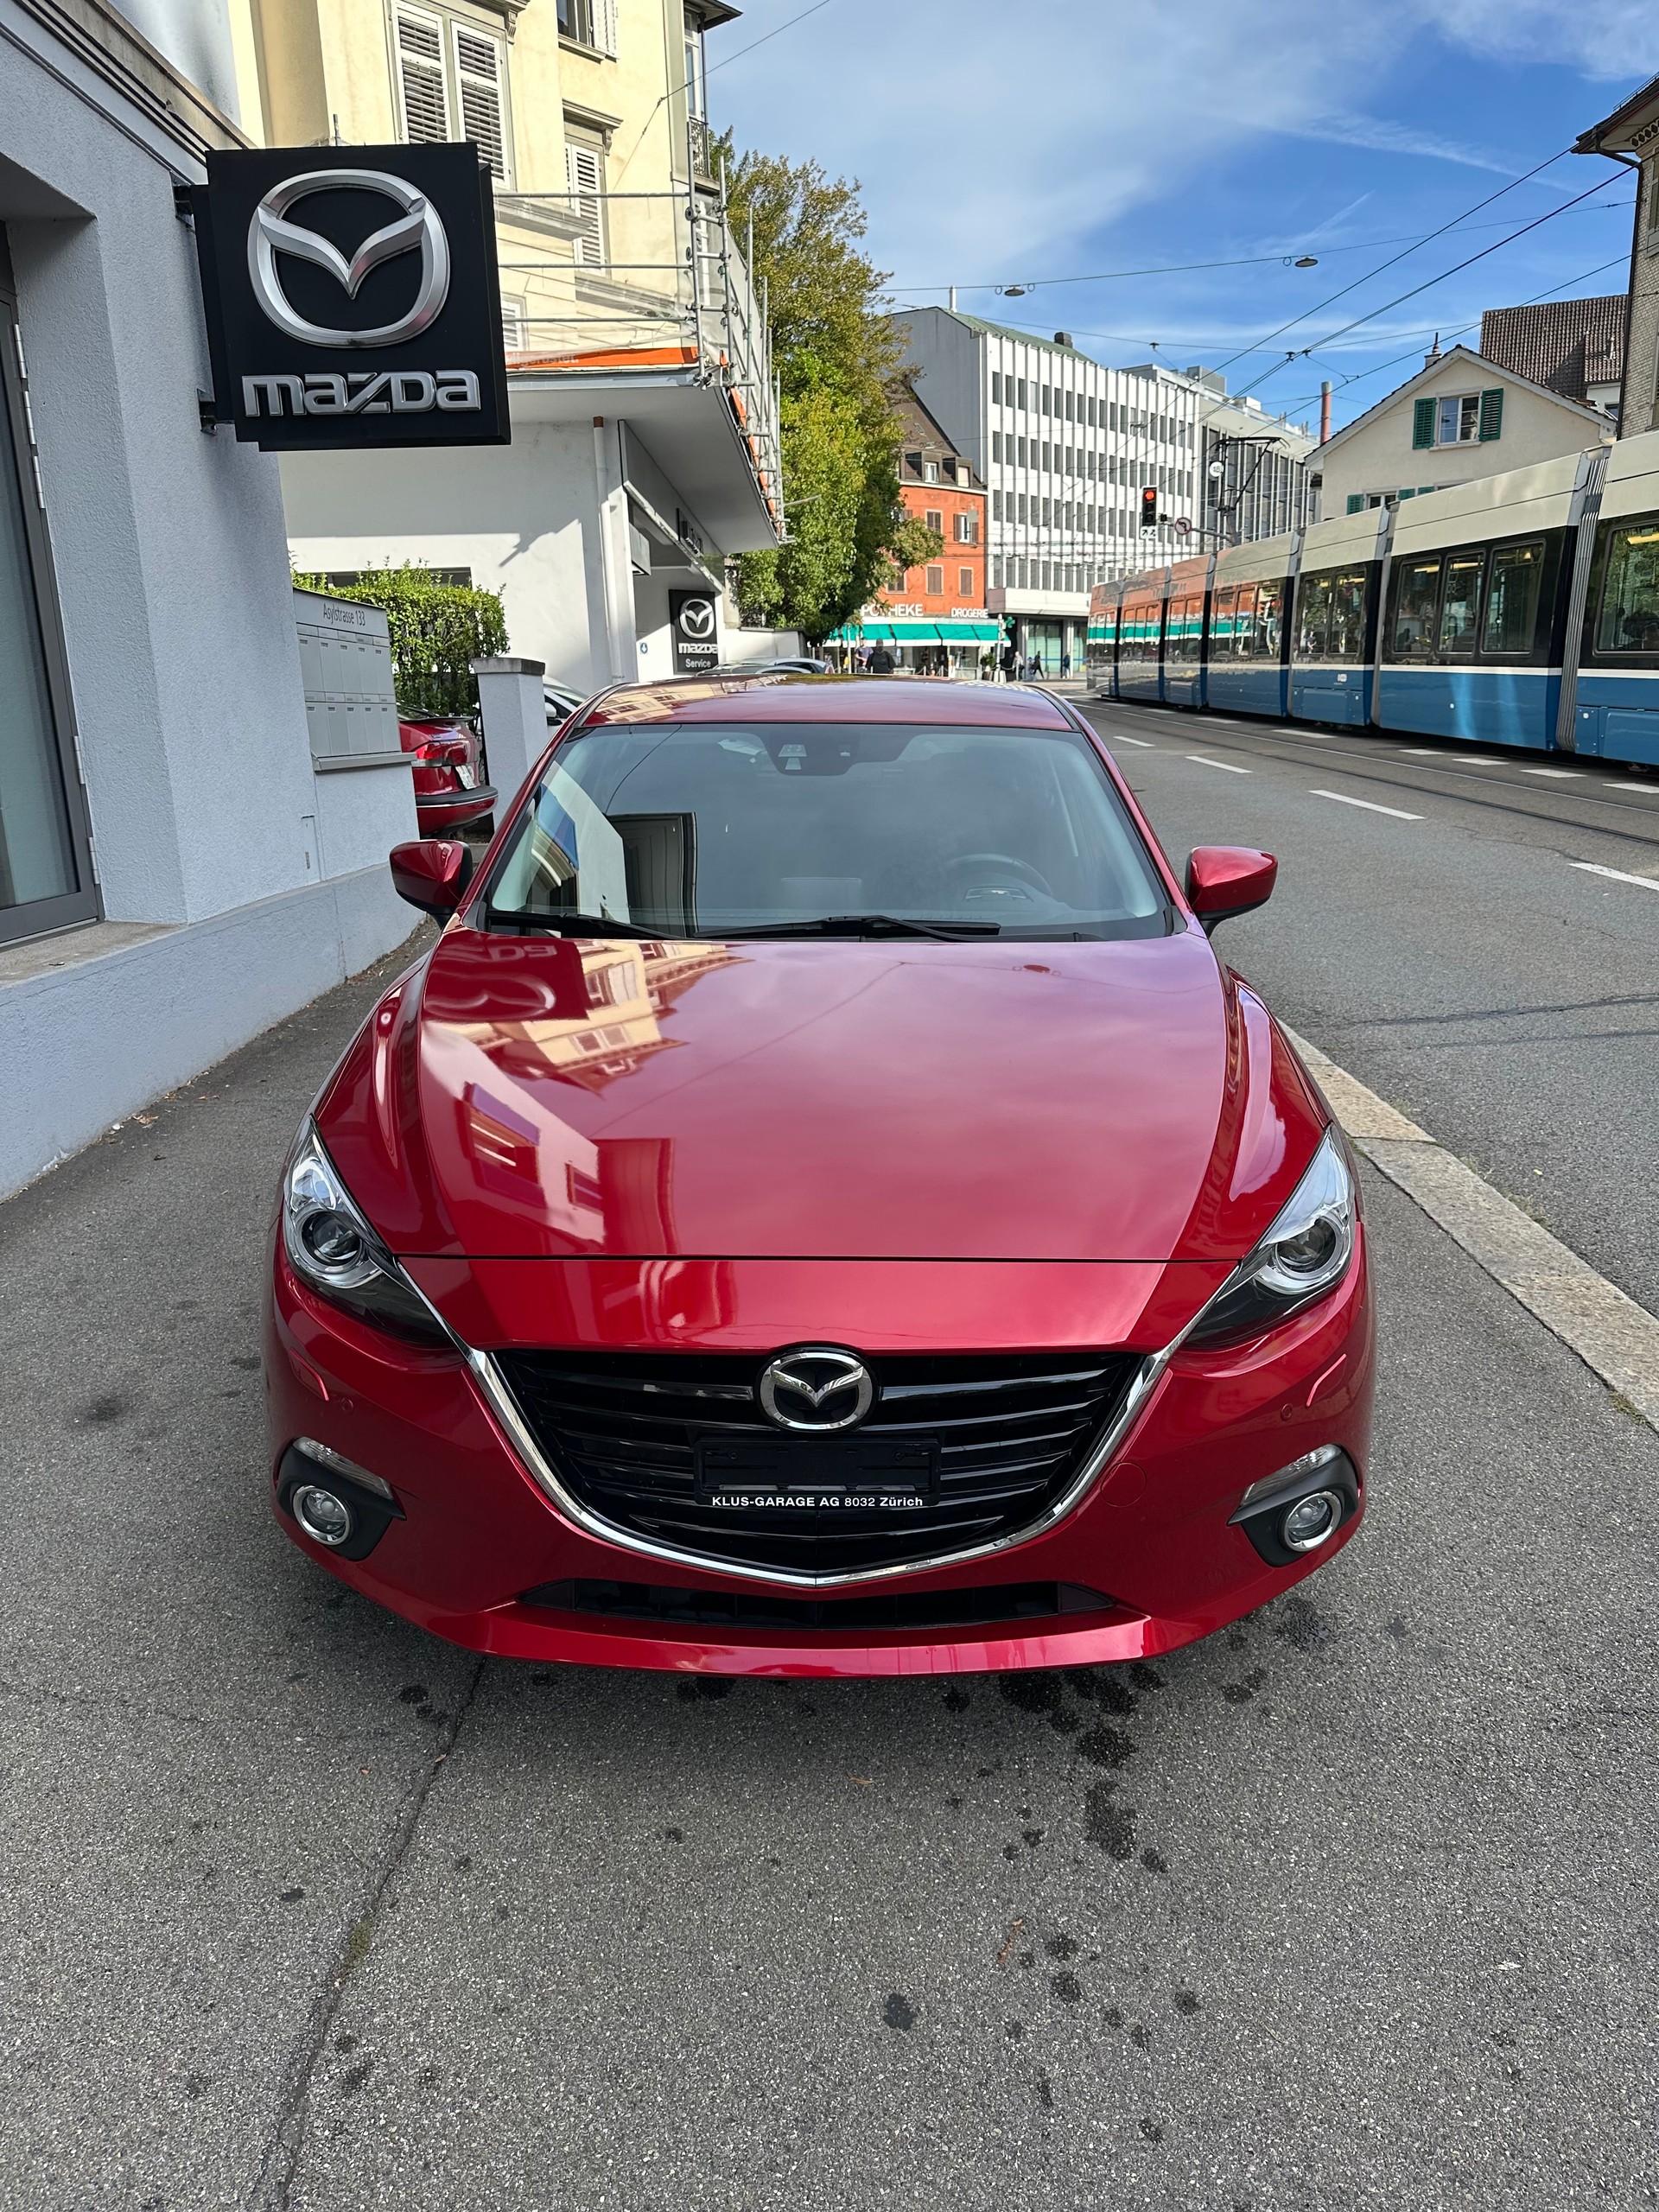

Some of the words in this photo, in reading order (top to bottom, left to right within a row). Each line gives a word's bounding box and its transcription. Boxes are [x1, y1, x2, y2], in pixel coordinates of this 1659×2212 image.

[323, 603, 354, 625] Asylstrasse
[355, 609, 365, 626] 133
[950, 607, 989, 619] DROGERIE
[685, 658, 711, 668] Service
[712, 1497, 815, 1507] KLUS-GARAGE
[820, 1497, 840, 1507] AG
[844, 1497, 875, 1507] 8032
[880, 1497, 923, 1507] Zürich
